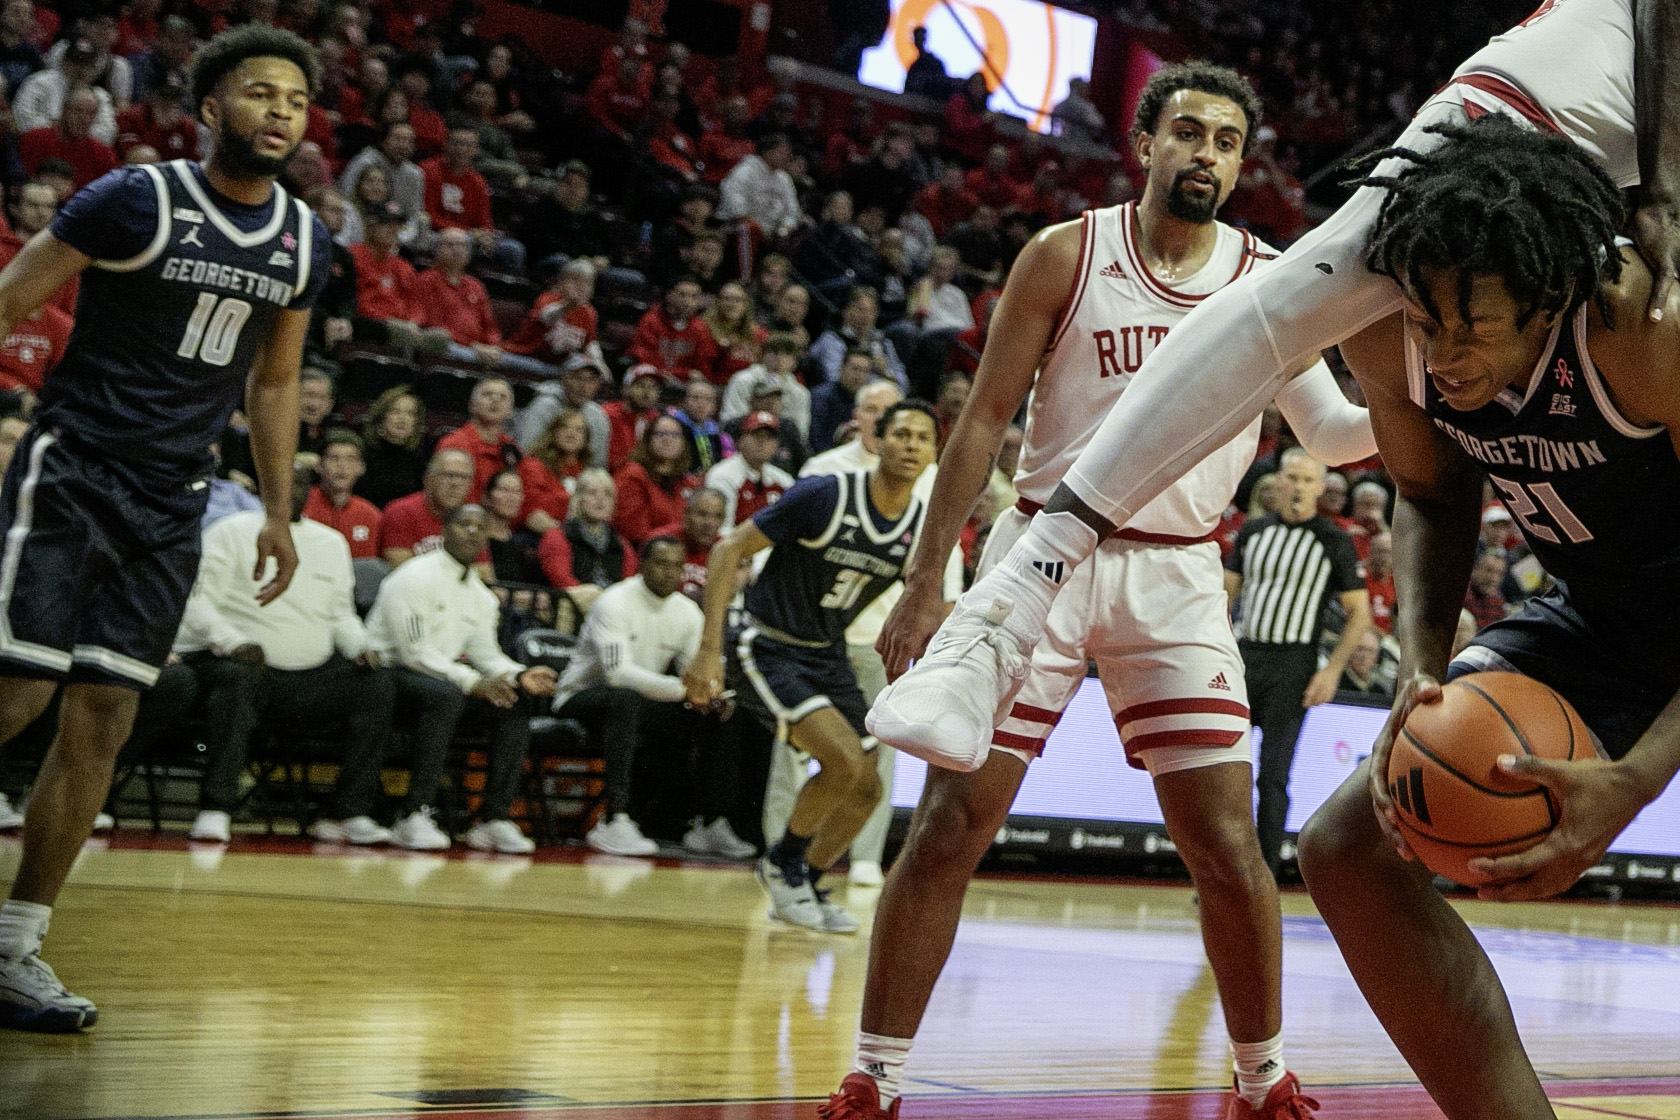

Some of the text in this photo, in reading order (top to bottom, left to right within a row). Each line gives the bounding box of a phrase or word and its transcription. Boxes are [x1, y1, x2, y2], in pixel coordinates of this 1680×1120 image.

[177, 291, 253, 367] 10
[1488, 472, 1595, 544] 21
[819, 568, 874, 610] 31
